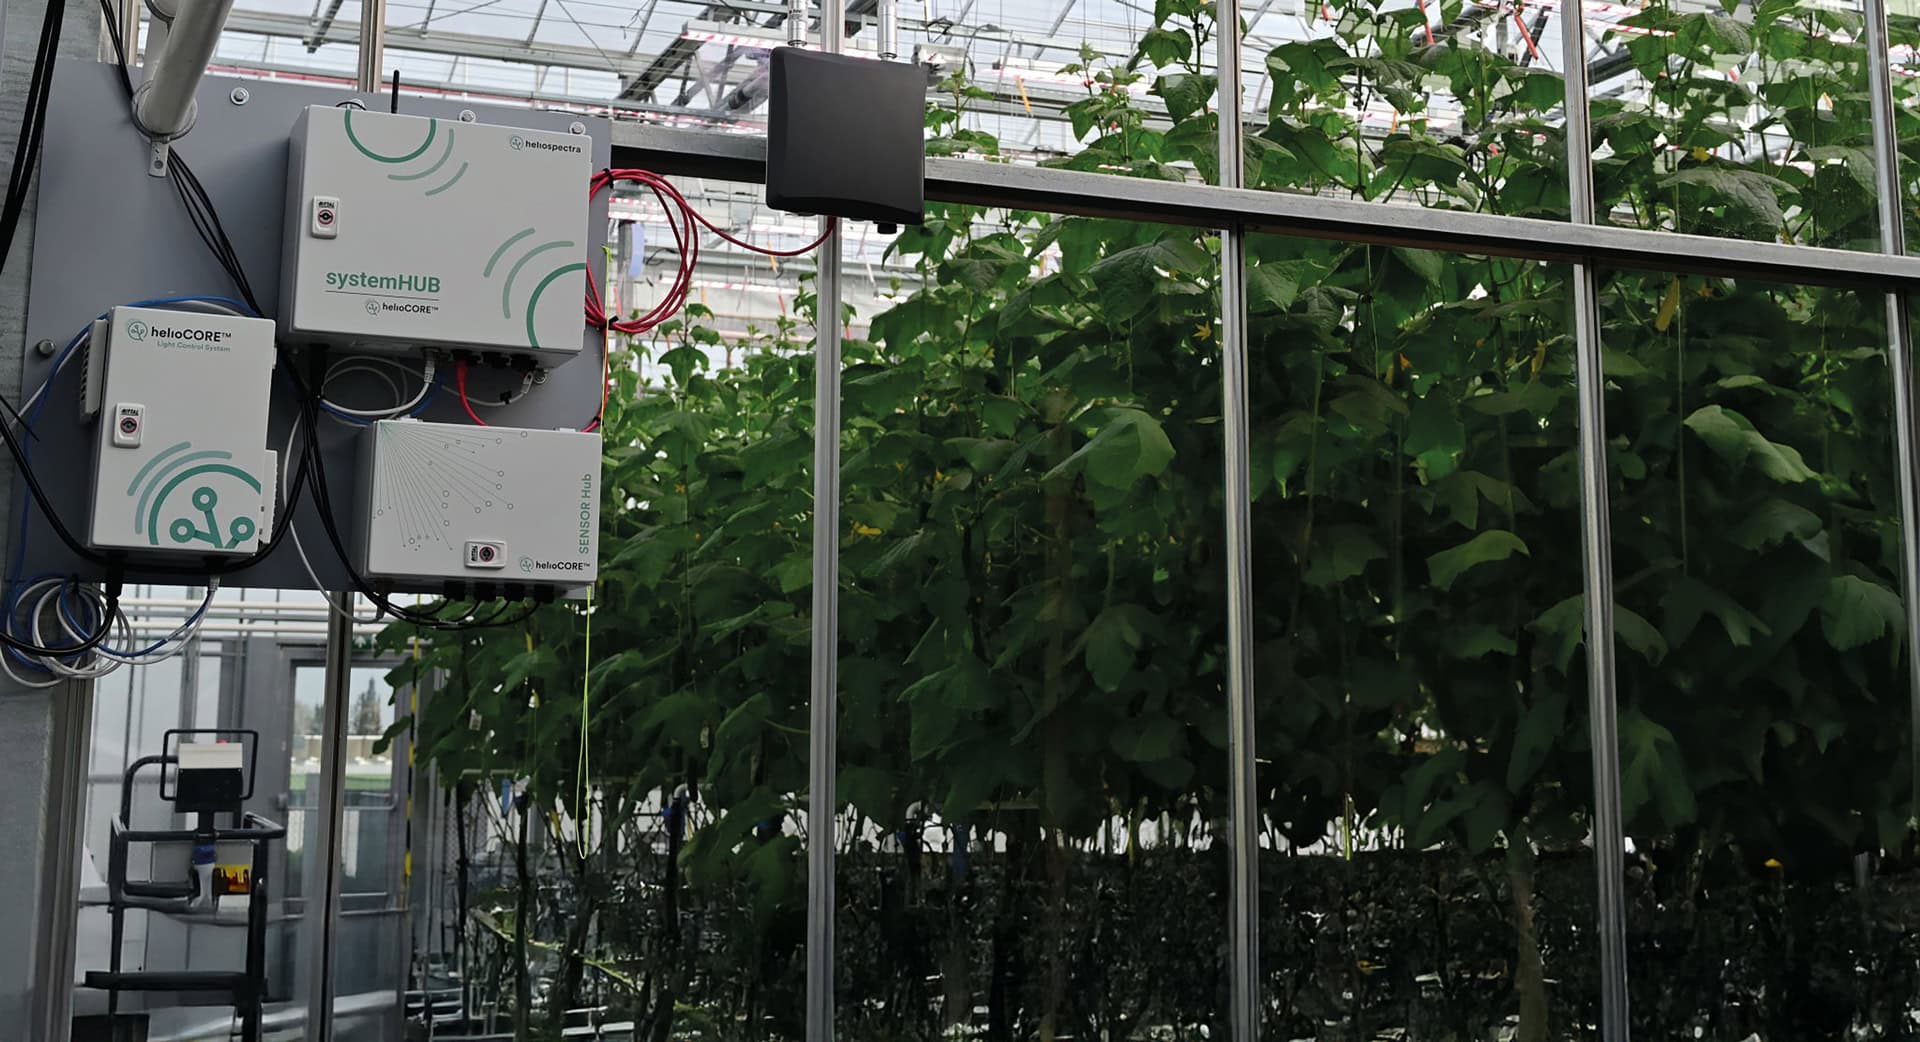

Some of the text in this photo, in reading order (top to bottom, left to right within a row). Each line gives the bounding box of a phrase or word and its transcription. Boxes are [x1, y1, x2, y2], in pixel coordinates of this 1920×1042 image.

[525, 140, 582, 153] heliospectra
[325, 271, 441, 293] systemHUB
[157, 341, 230, 352] Light Control System
[579, 473, 592, 554] SENSOR Hub
